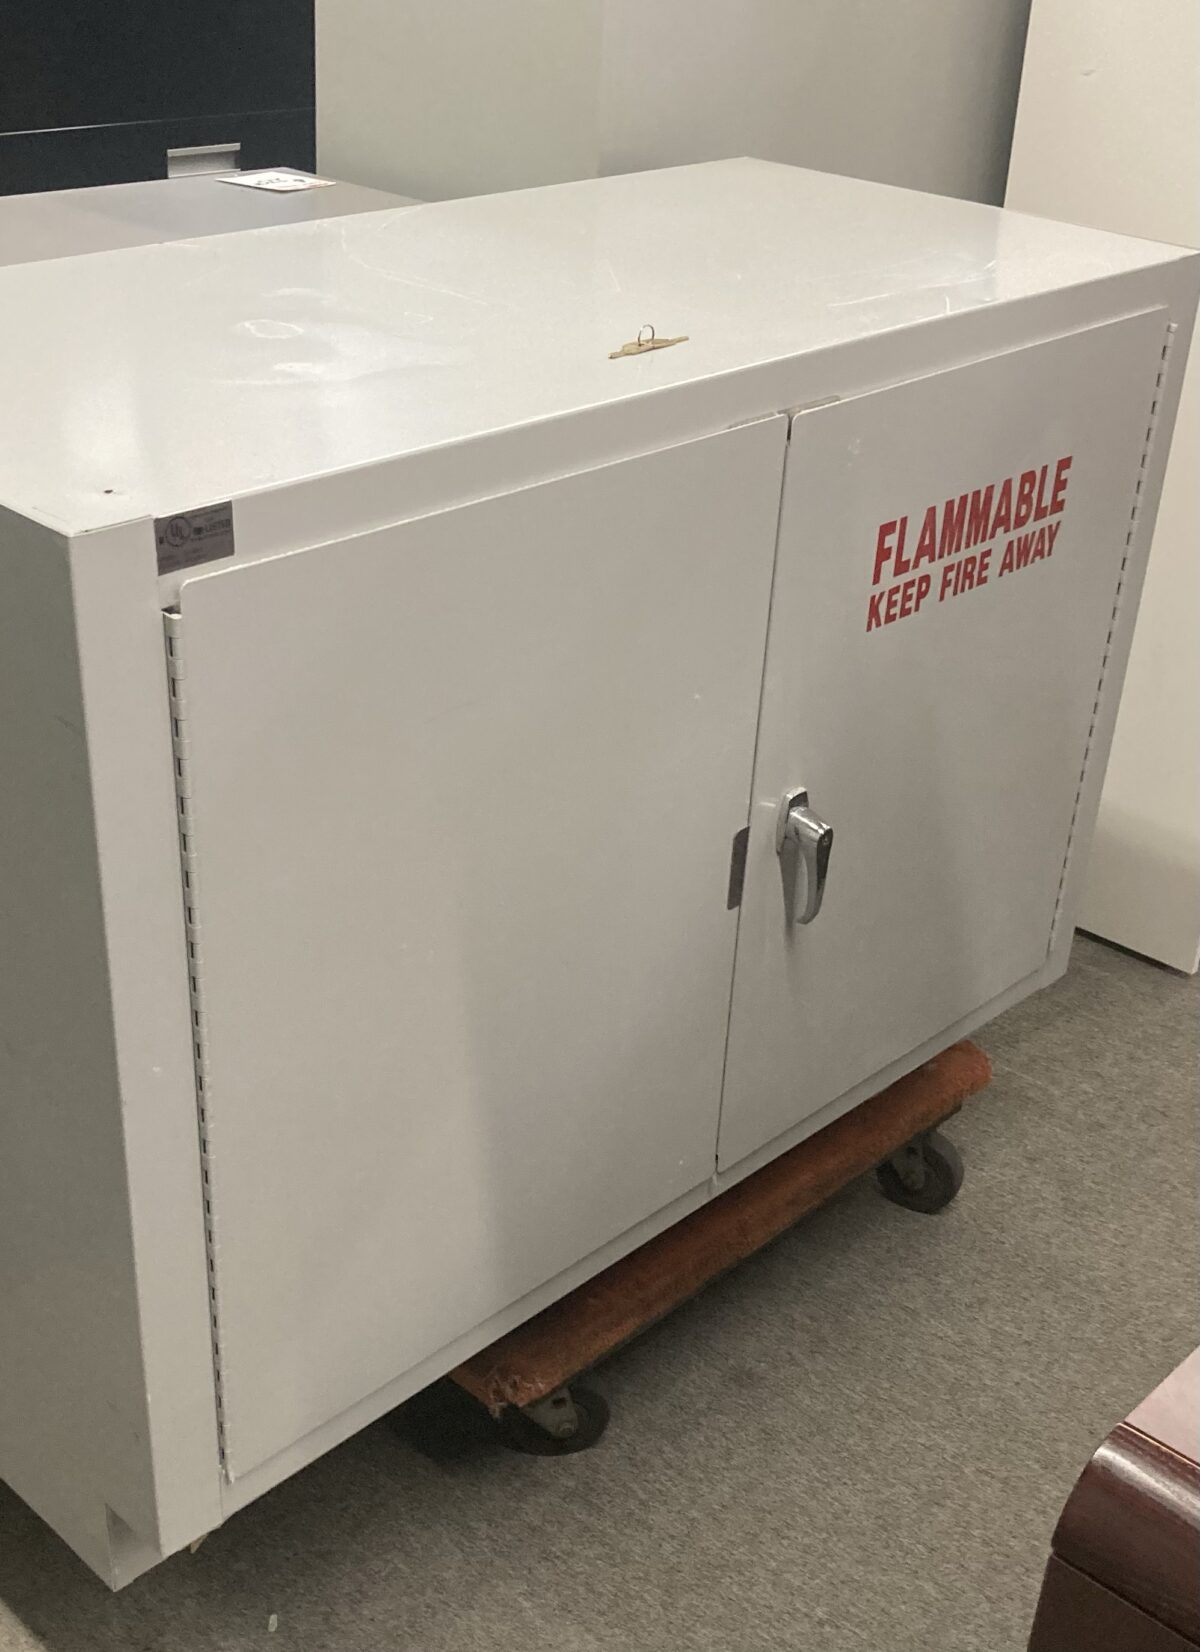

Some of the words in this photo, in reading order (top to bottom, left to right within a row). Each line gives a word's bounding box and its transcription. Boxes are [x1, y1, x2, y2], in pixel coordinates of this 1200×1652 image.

[866, 574, 931, 632] KEEP
[938, 548, 993, 602] FIRE
[998, 520, 1062, 578] AWAY
[872, 456, 1073, 585] FLAMMABLE
